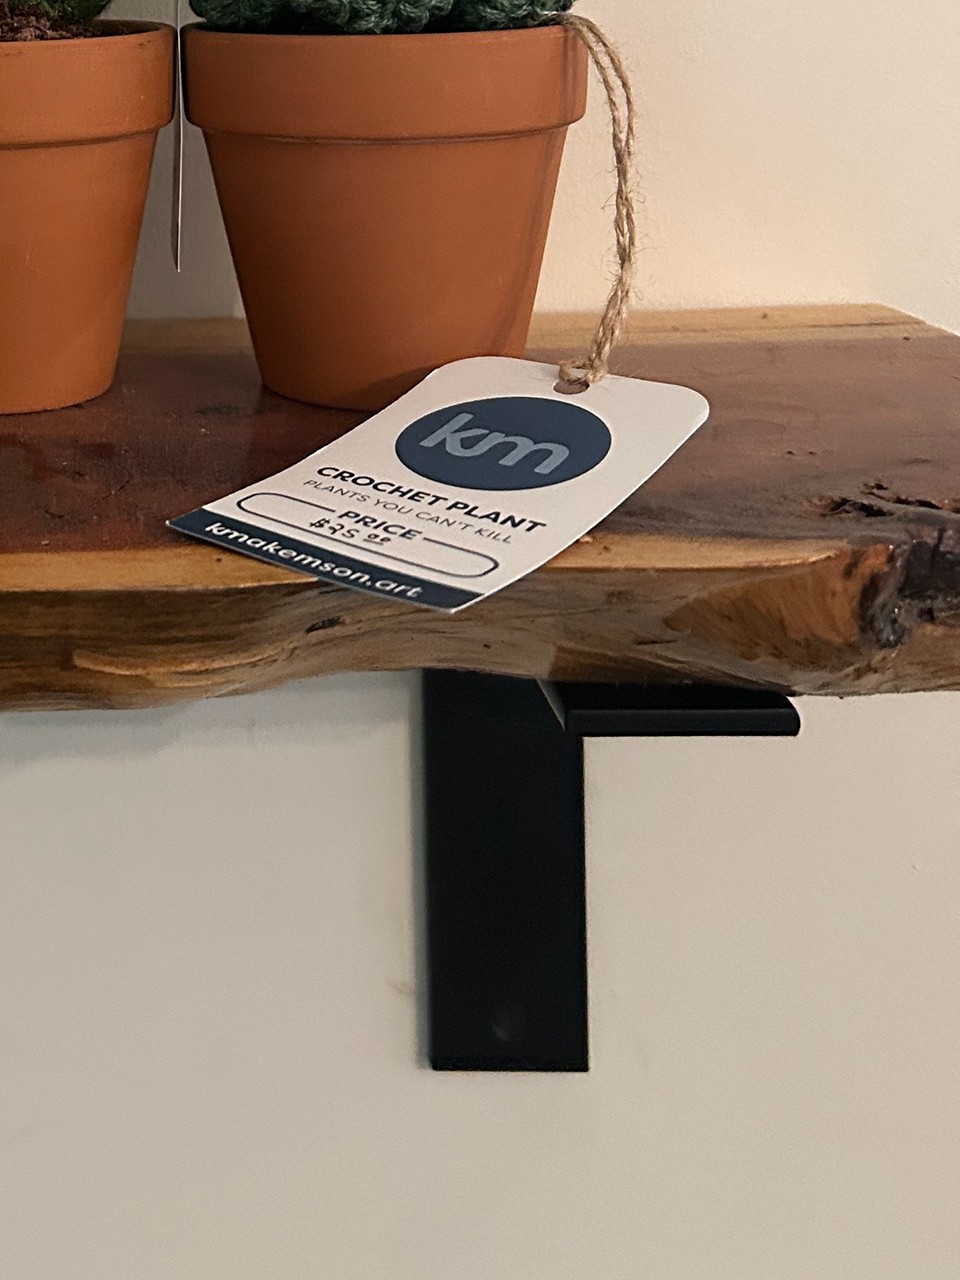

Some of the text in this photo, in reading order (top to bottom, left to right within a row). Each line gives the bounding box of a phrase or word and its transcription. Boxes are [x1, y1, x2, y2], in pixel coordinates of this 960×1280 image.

[419, 412, 570, 475] km
[303, 478, 512, 545] PLANTS YOU CAN'T KILL
[316, 466, 547, 533] CROCHET PLANT
[337, 509, 424, 541] PRICE
[203, 520, 423, 600] kmakemson.art
